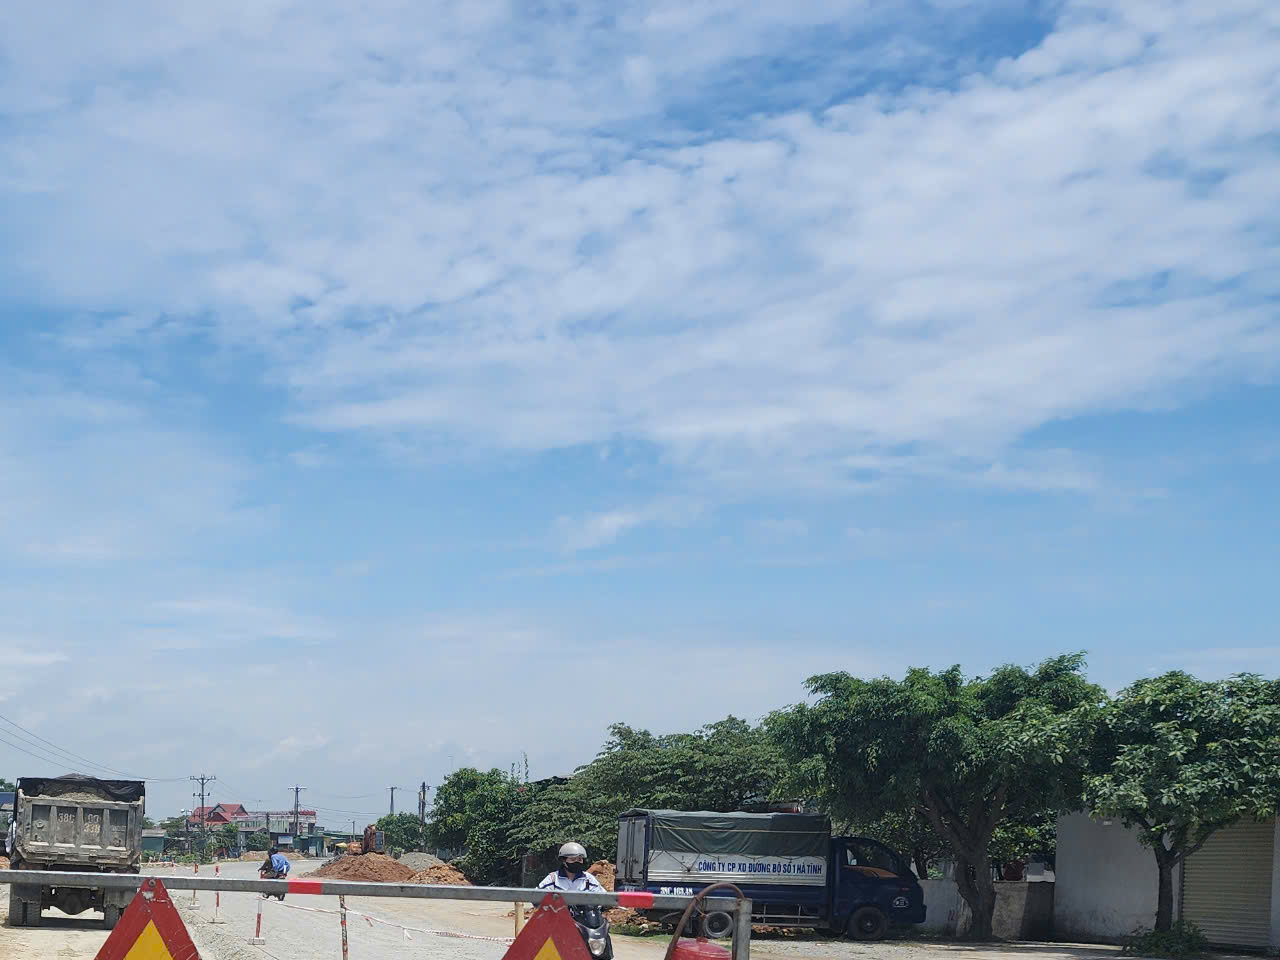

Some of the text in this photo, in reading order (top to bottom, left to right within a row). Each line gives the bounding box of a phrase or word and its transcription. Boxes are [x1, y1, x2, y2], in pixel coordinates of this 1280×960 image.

[698, 859, 716, 872] CÔNG
[718, 862, 725, 872] TY
[727, 862, 736, 872] CP
[738, 862, 747, 873] XD
[796, 862, 806, 875] HÀ
